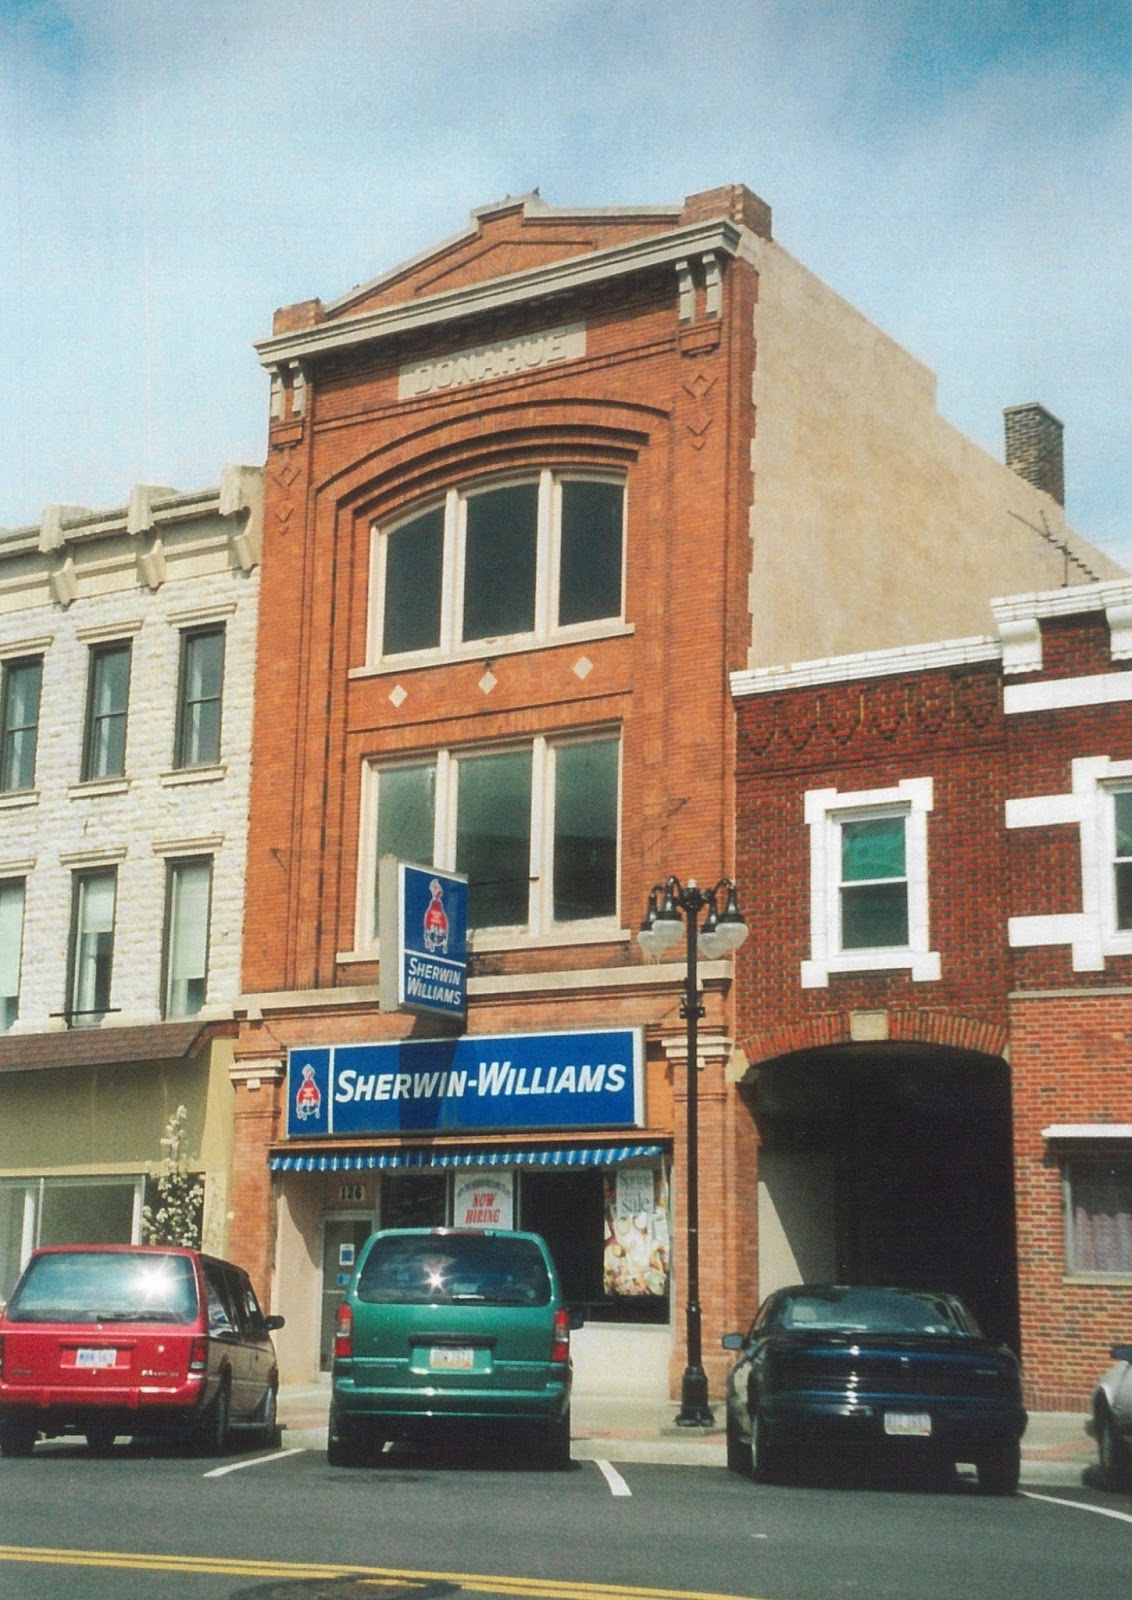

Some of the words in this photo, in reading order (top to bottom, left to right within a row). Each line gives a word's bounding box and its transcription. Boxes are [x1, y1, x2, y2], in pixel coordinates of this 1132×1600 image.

[414, 332, 568, 395] DONAHUE
[408, 957, 461, 986] SHERWIN
[407, 976, 462, 1006] WILLIAMS
[335, 1061, 627, 1104] SHERWIN-WILLIAMS
[472, 1192, 498, 1208] NOW
[465, 1208, 501, 1225] HIRING
